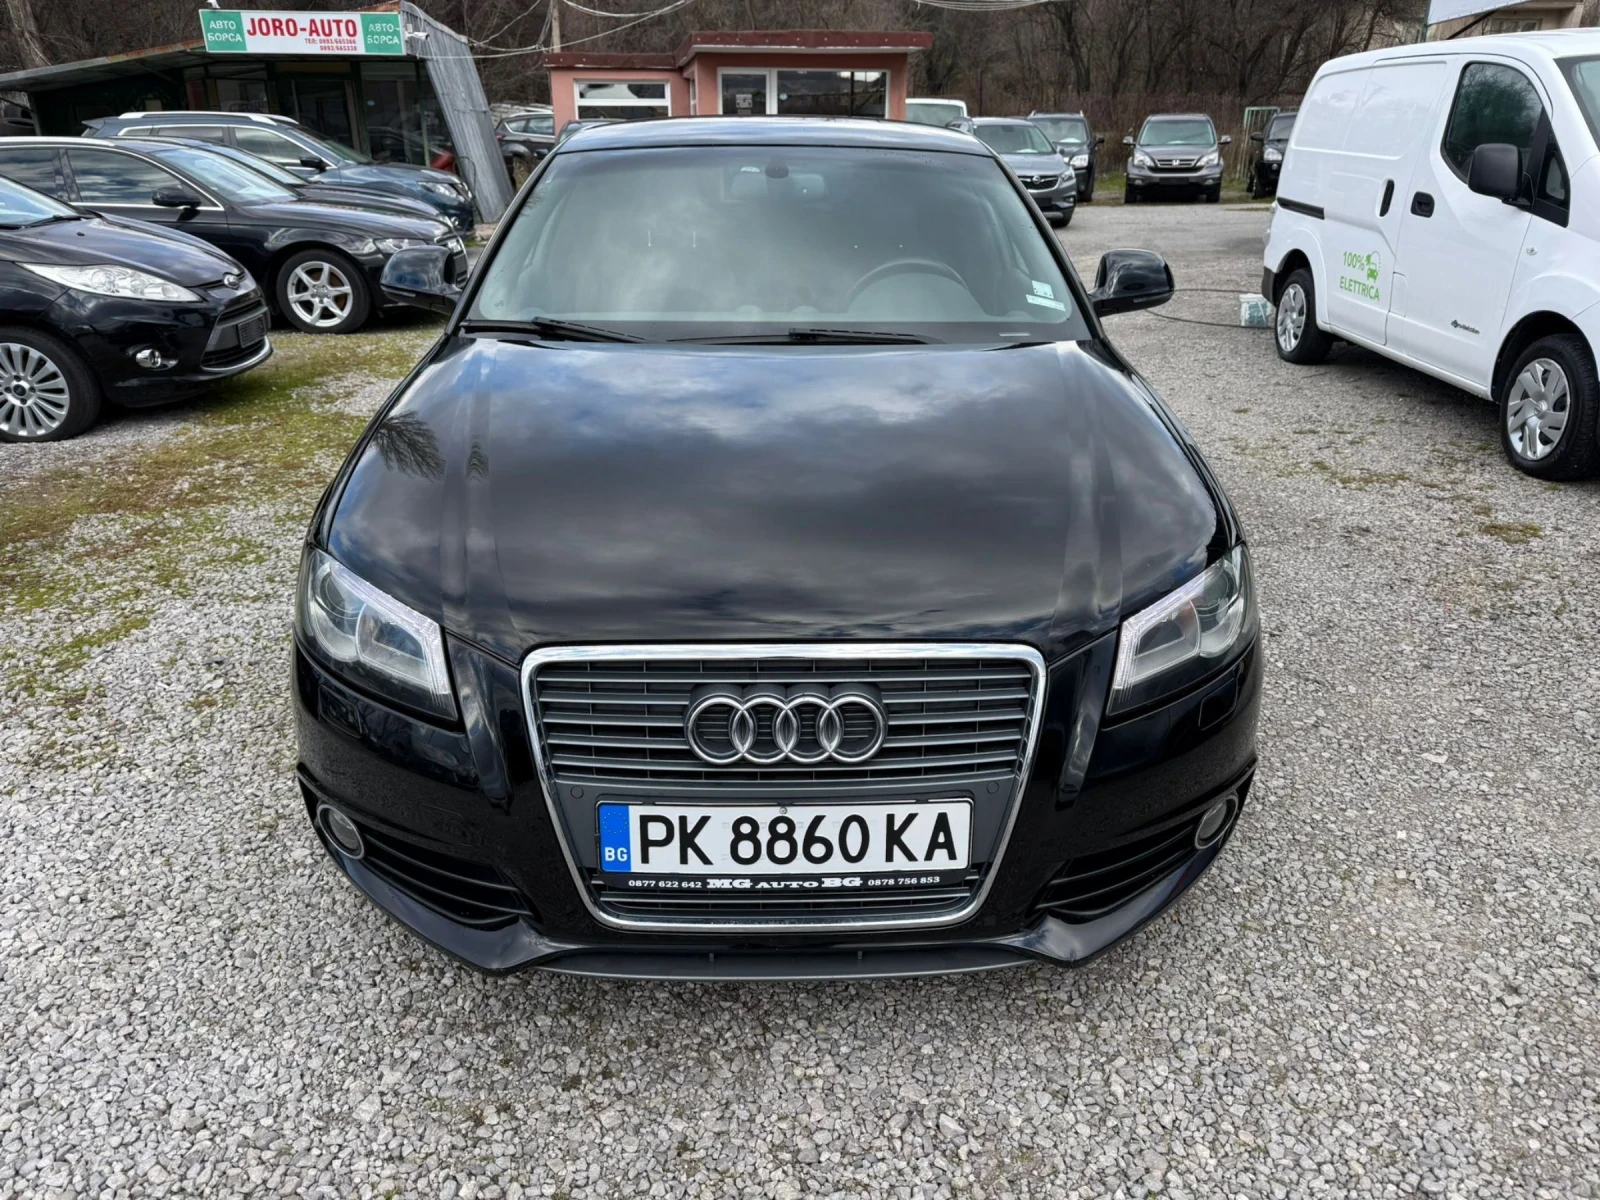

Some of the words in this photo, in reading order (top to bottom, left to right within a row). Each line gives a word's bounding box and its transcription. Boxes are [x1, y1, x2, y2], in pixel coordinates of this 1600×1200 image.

[209, 20, 236, 30] АВТО
[246, 17, 358, 38] JORO-AUTO
[207, 32, 243, 43] БОРСА
[367, 35, 400, 44] БОРСА
[1343, 251, 1365, 272] 100%
[1339, 276, 1380, 301] ELETTRICA
[638, 814, 714, 866] PK
[729, 813, 870, 866] 8860
[885, 811, 958, 863] KA
[604, 846, 628, 862] BG
[628, 879, 656, 888] 0877
[658, 880, 679, 888] 622
[681, 880, 702, 889] 642
[706, 878, 753, 889] MG
[821, 877, 863, 888] BG
[868, 878, 895, 886] 0878
[897, 877, 918, 885] 756
[919, 876, 940, 884] 853
